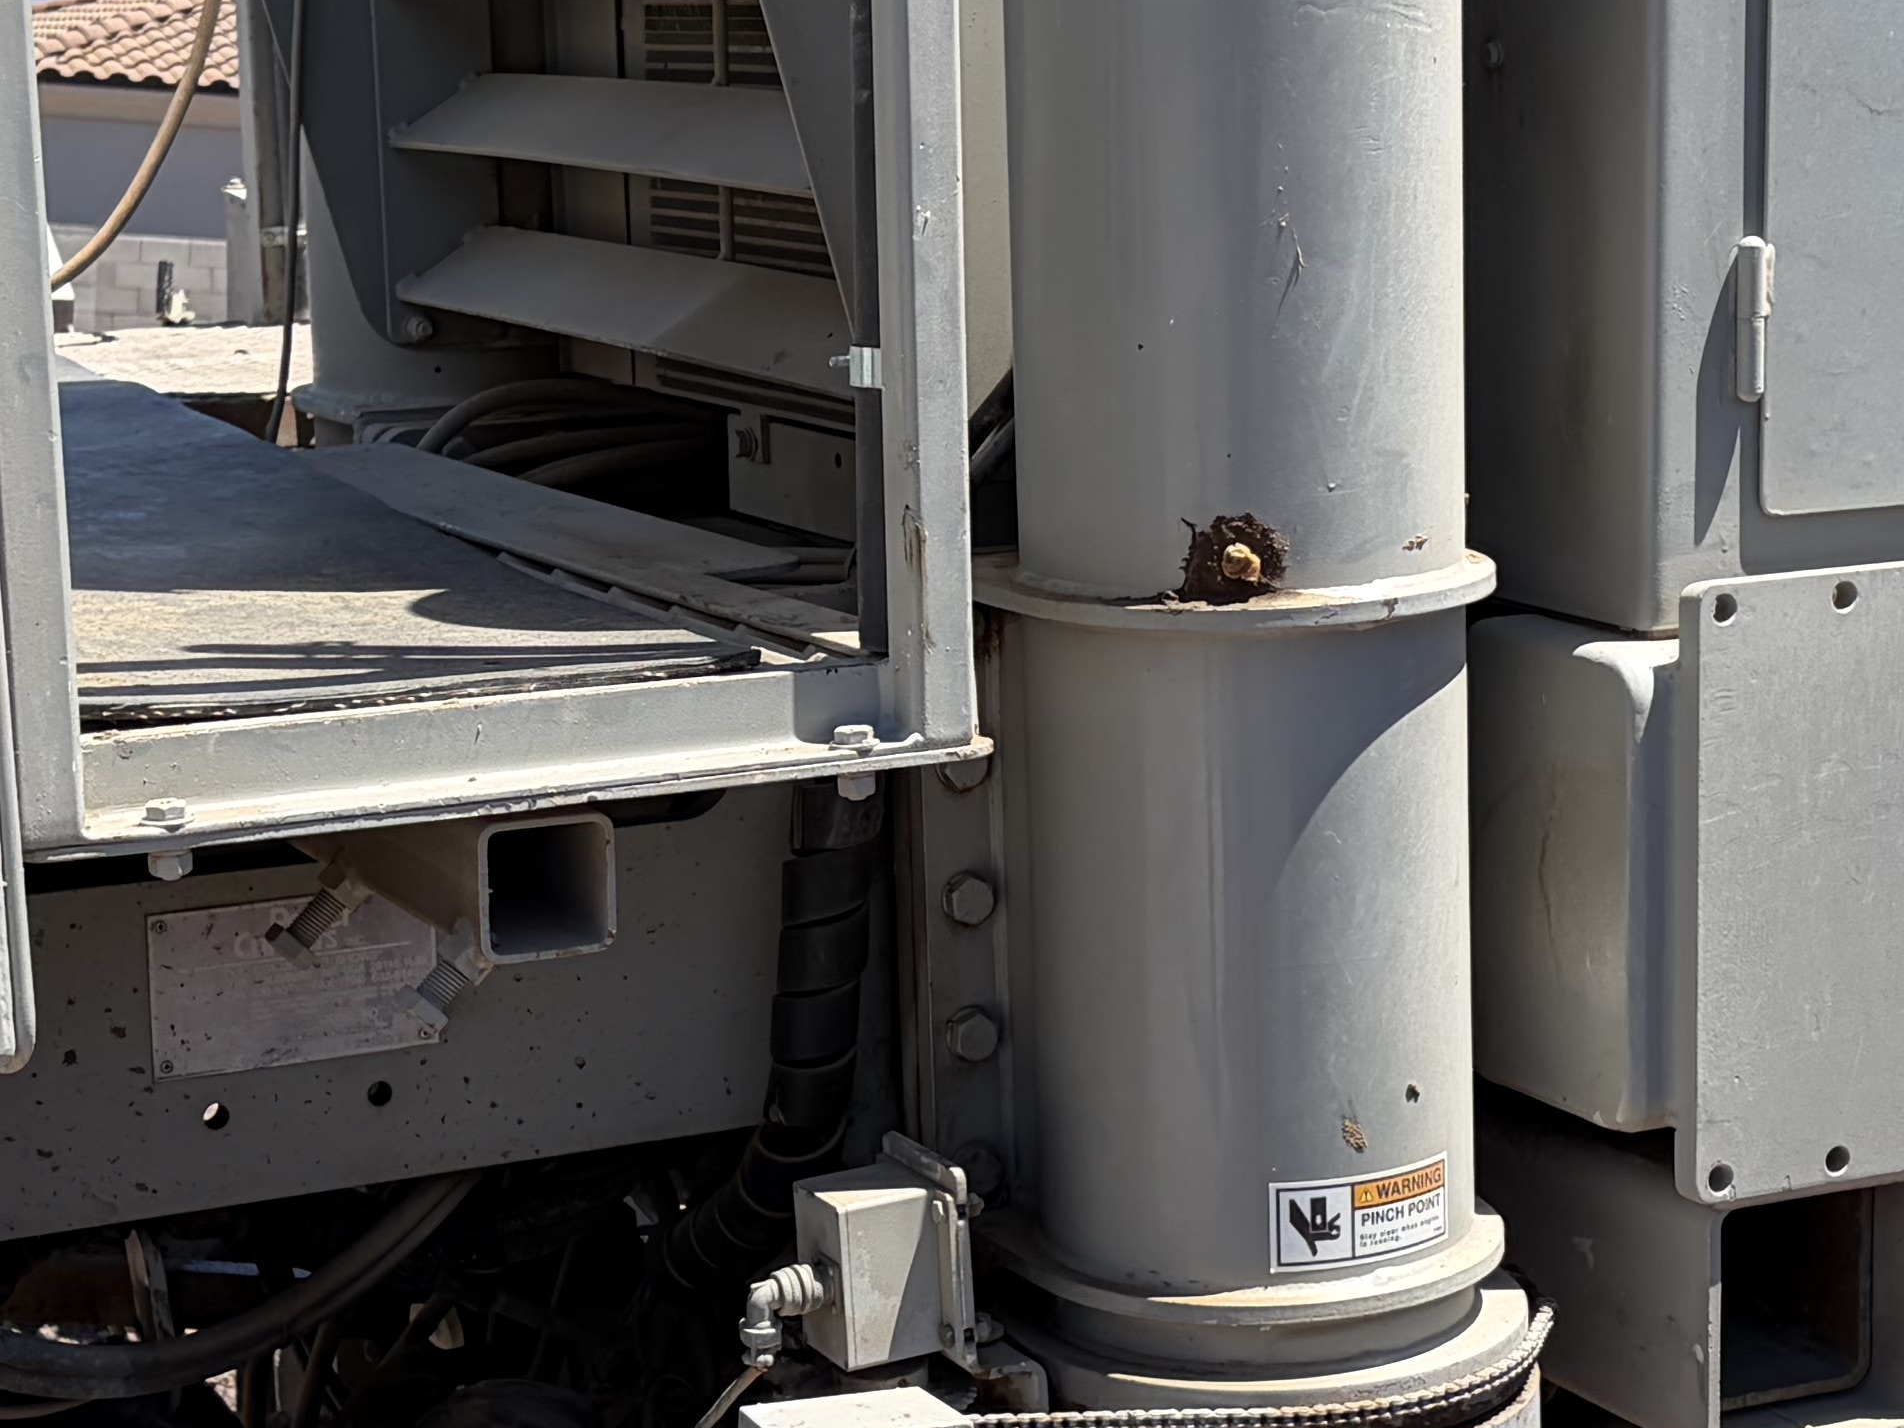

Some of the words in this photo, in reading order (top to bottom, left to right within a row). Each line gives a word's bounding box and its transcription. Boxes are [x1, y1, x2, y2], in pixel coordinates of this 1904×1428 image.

[1376, 1168, 1441, 1199] WARNING
[1361, 1205, 1404, 1226] PINCH
[1408, 1193, 1441, 1216] POINT
